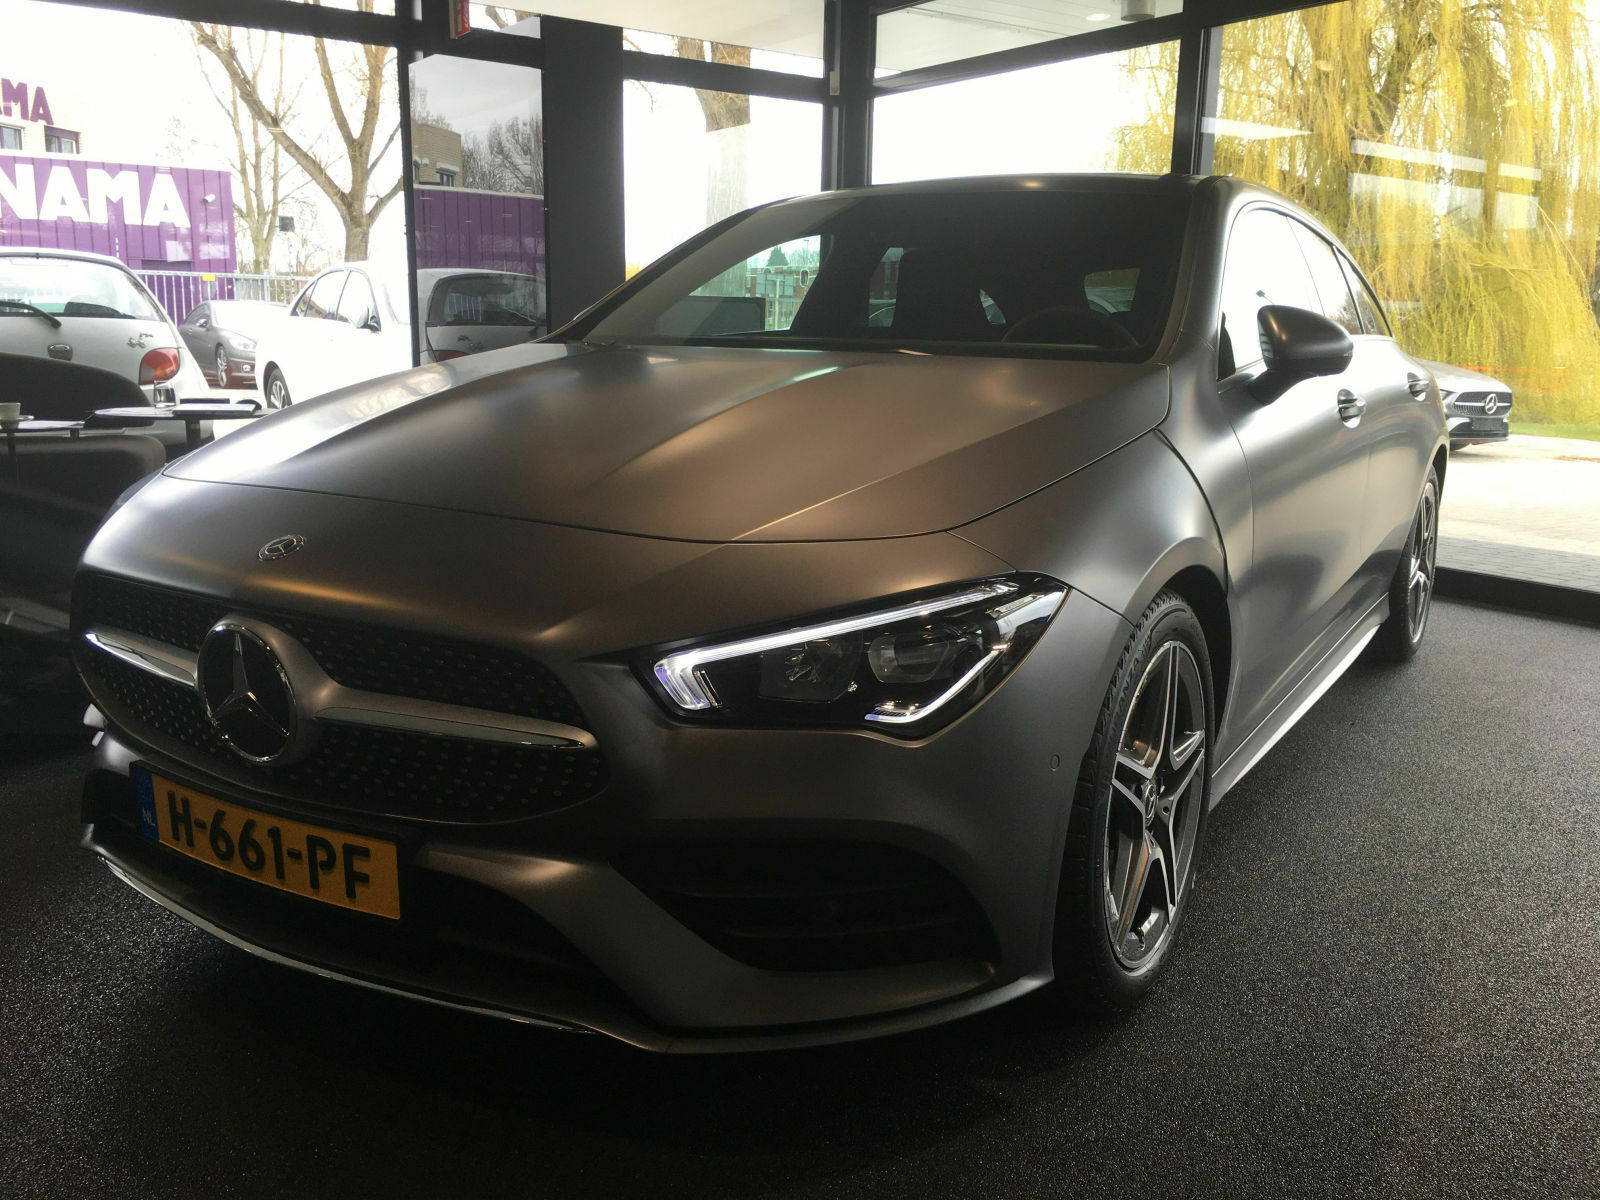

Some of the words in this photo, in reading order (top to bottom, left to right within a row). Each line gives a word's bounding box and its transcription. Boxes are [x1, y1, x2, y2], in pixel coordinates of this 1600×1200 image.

[0, 78, 54, 126] MA
[142, 807, 156, 827] NL
[167, 791, 370, 899] H-661-PF
